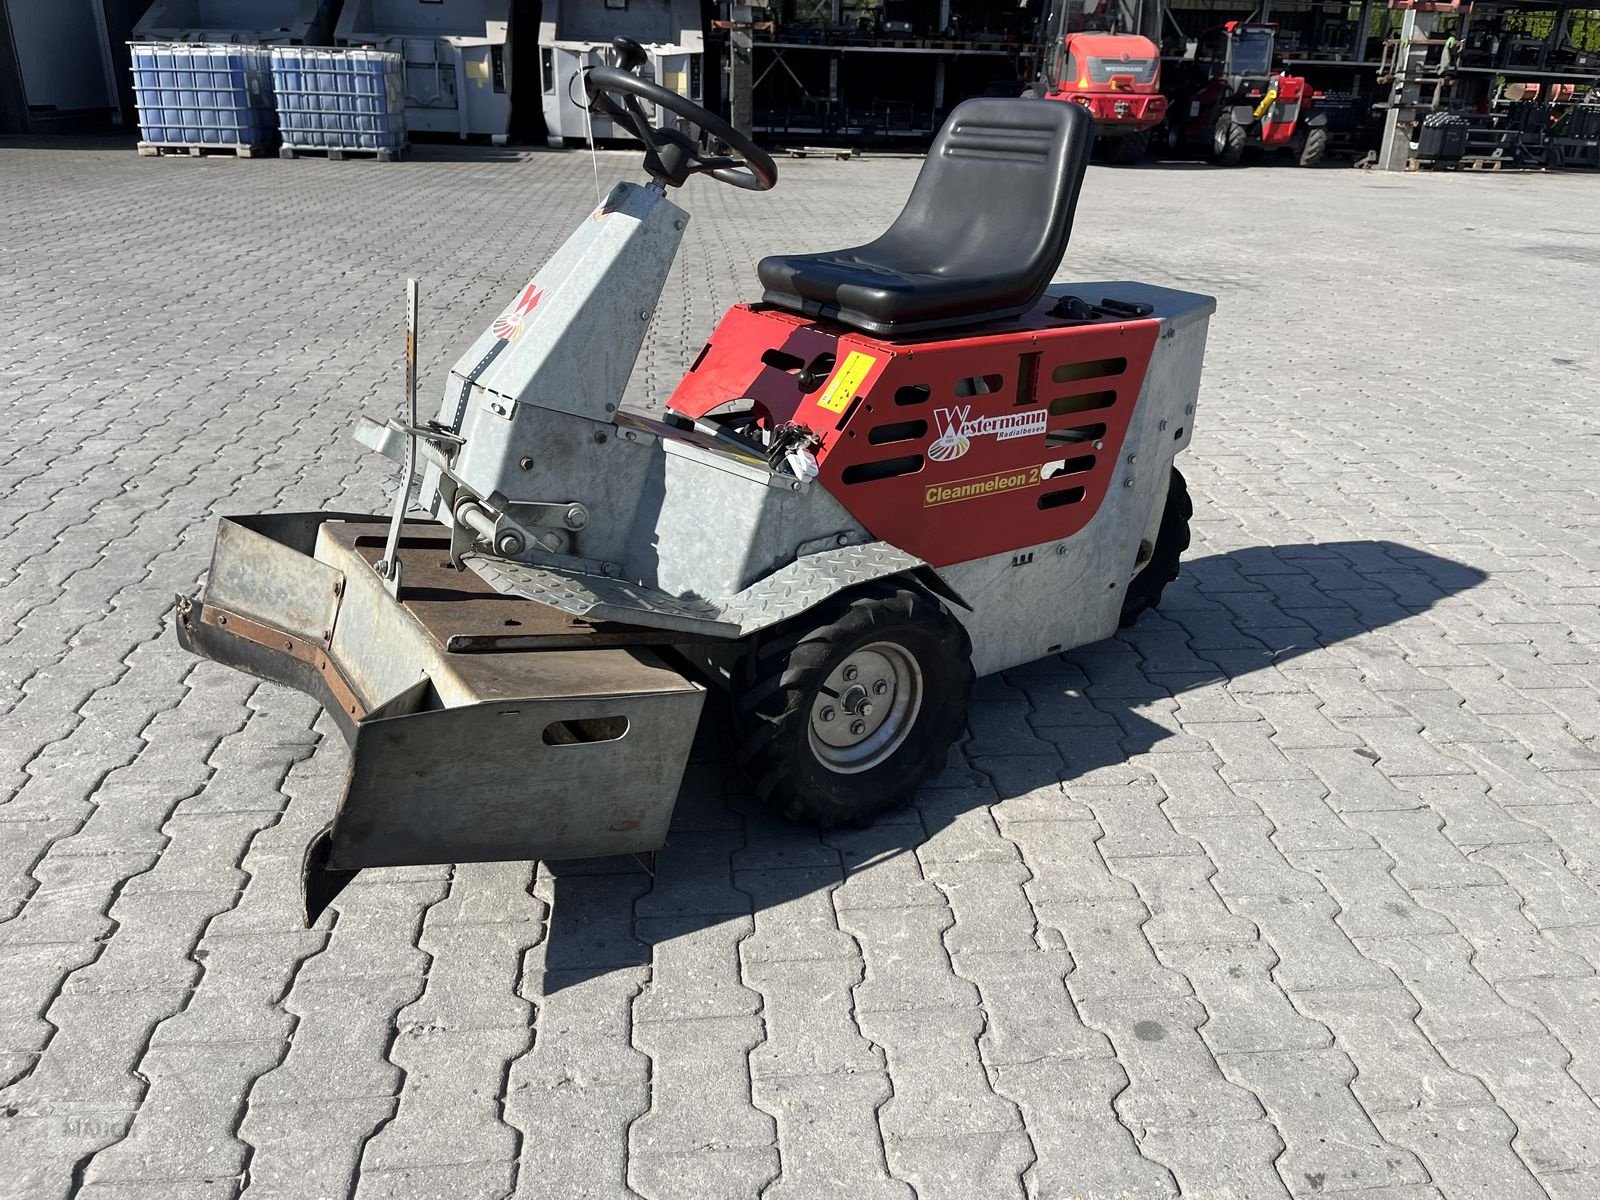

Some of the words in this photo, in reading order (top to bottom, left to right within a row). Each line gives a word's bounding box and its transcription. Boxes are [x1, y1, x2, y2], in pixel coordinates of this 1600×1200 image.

[934, 405, 1046, 438] Westermann
[999, 426, 1045, 439] Radialbesen
[926, 475, 1025, 502] Cleanmeleon
[1028, 469, 1039, 484] 2
